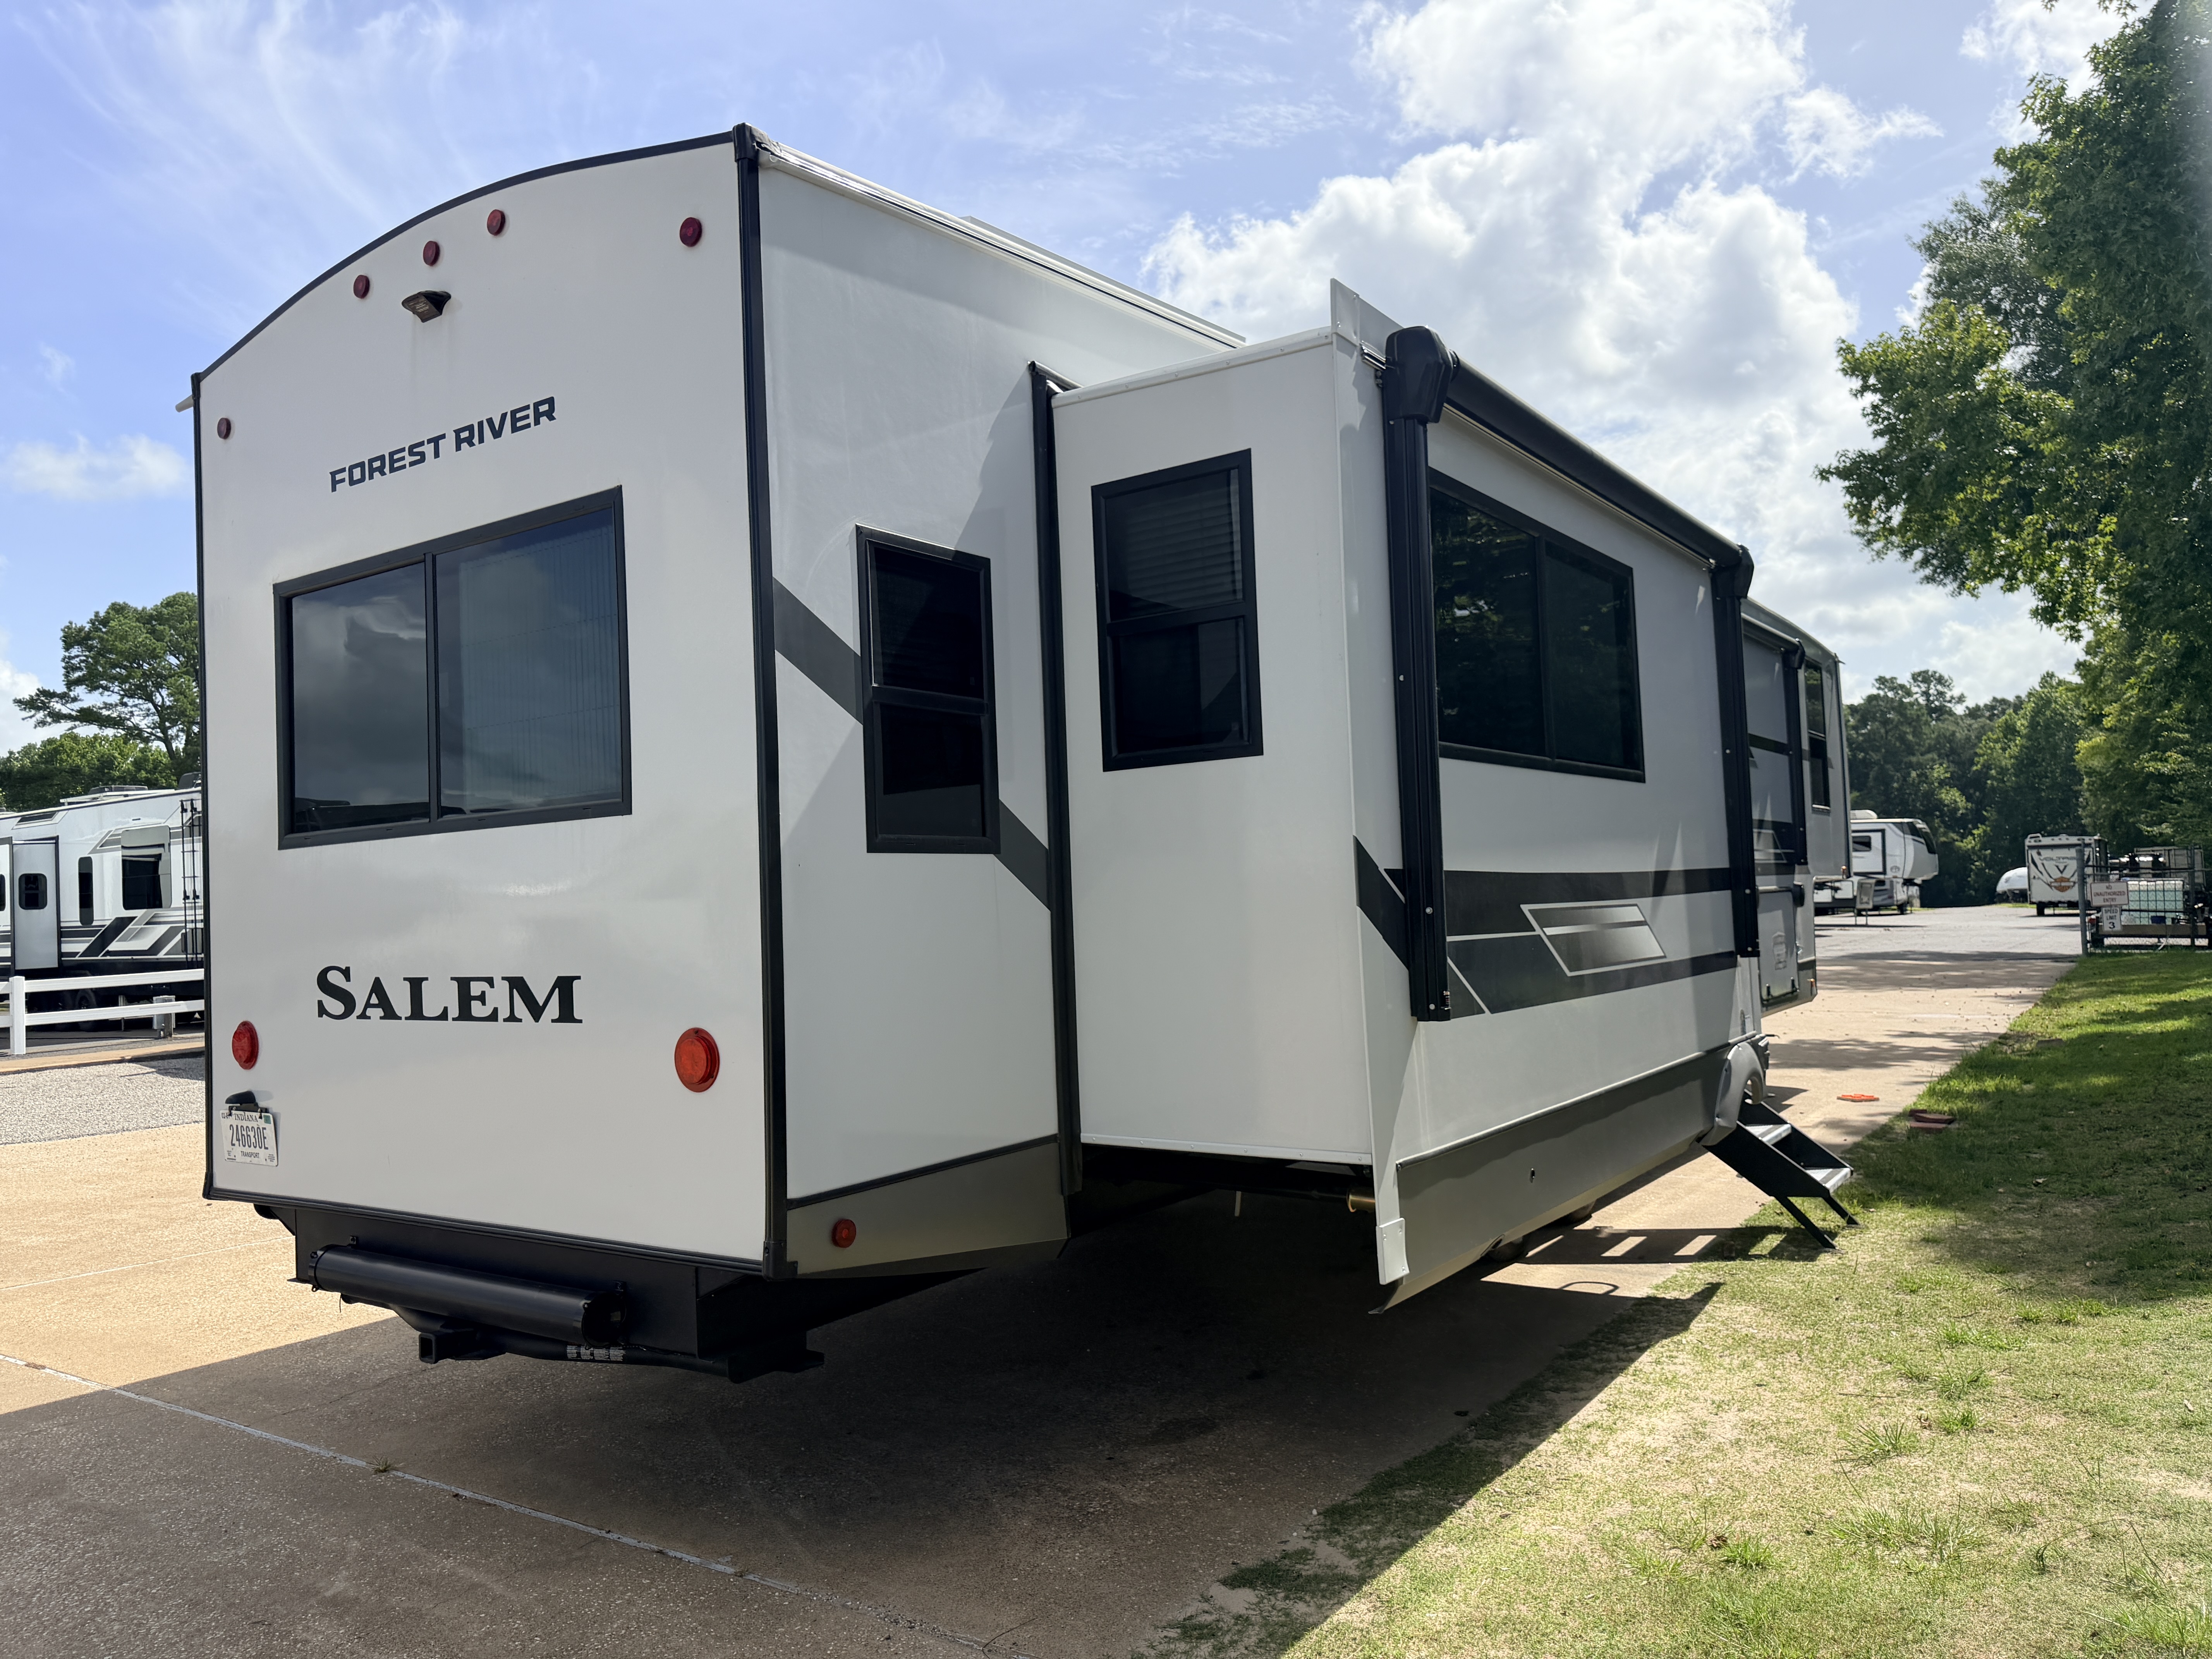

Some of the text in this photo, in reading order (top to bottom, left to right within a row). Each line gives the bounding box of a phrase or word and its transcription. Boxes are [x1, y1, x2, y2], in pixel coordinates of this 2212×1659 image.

[329, 396, 556, 493] FOREST RIVER
[234, 1113, 258, 1122] INDIANA
[229, 1124, 269, 1150] 246630E
[240, 1151, 260, 1159] TRANSPORT
